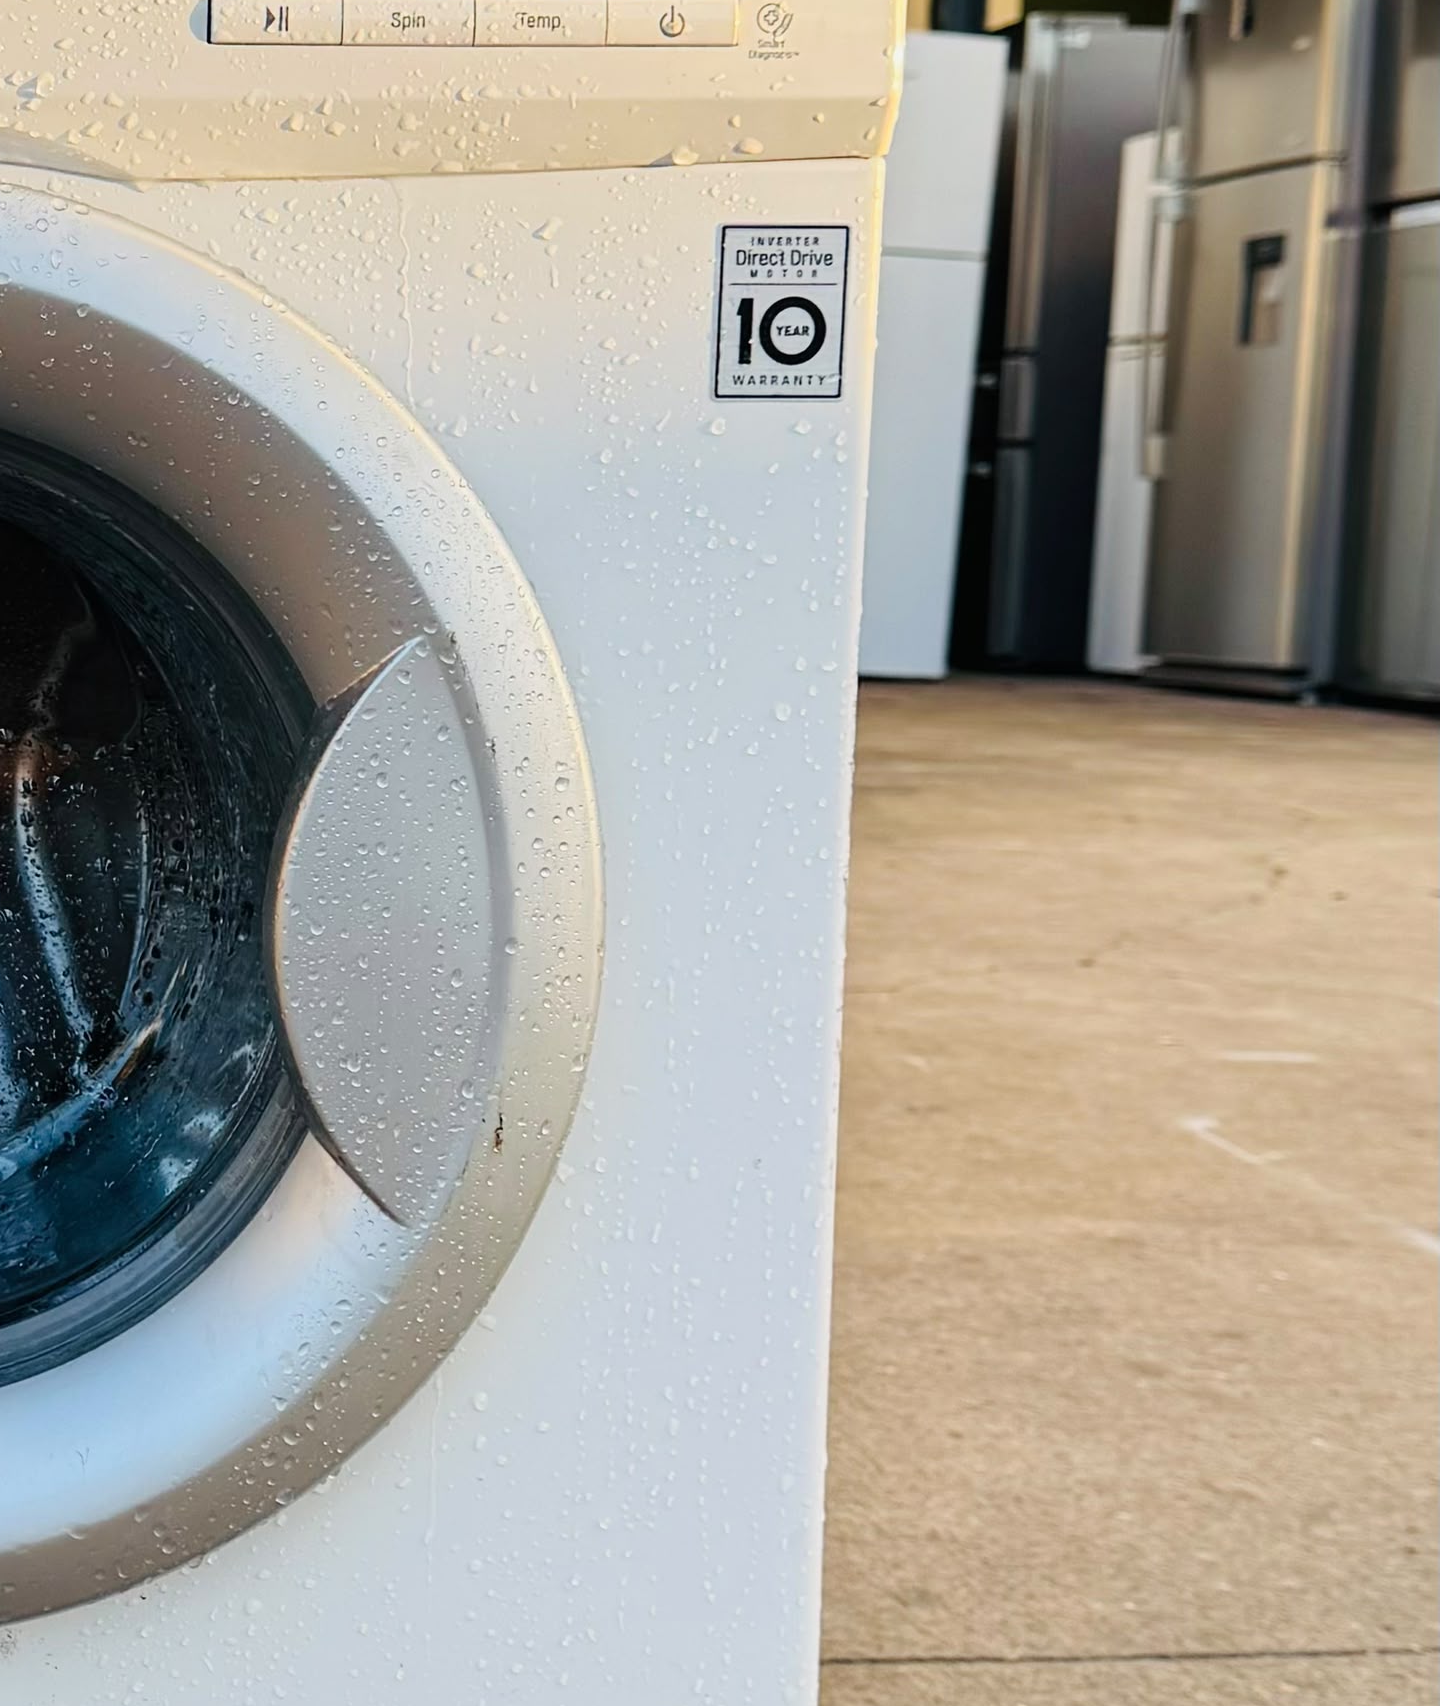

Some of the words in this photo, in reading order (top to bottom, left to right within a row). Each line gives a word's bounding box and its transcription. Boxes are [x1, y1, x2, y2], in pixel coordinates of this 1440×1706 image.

[391, 12, 426, 30] Spin
[751, 236, 820, 246] INVERTER
[736, 249, 785, 266] Direct
[790, 249, 833, 266] Drive
[750, 269, 818, 278] MOTOR
[736, 296, 827, 366] 10
[776, 325, 810, 337] YEAR
[732, 374, 826, 386] WARRANTY
